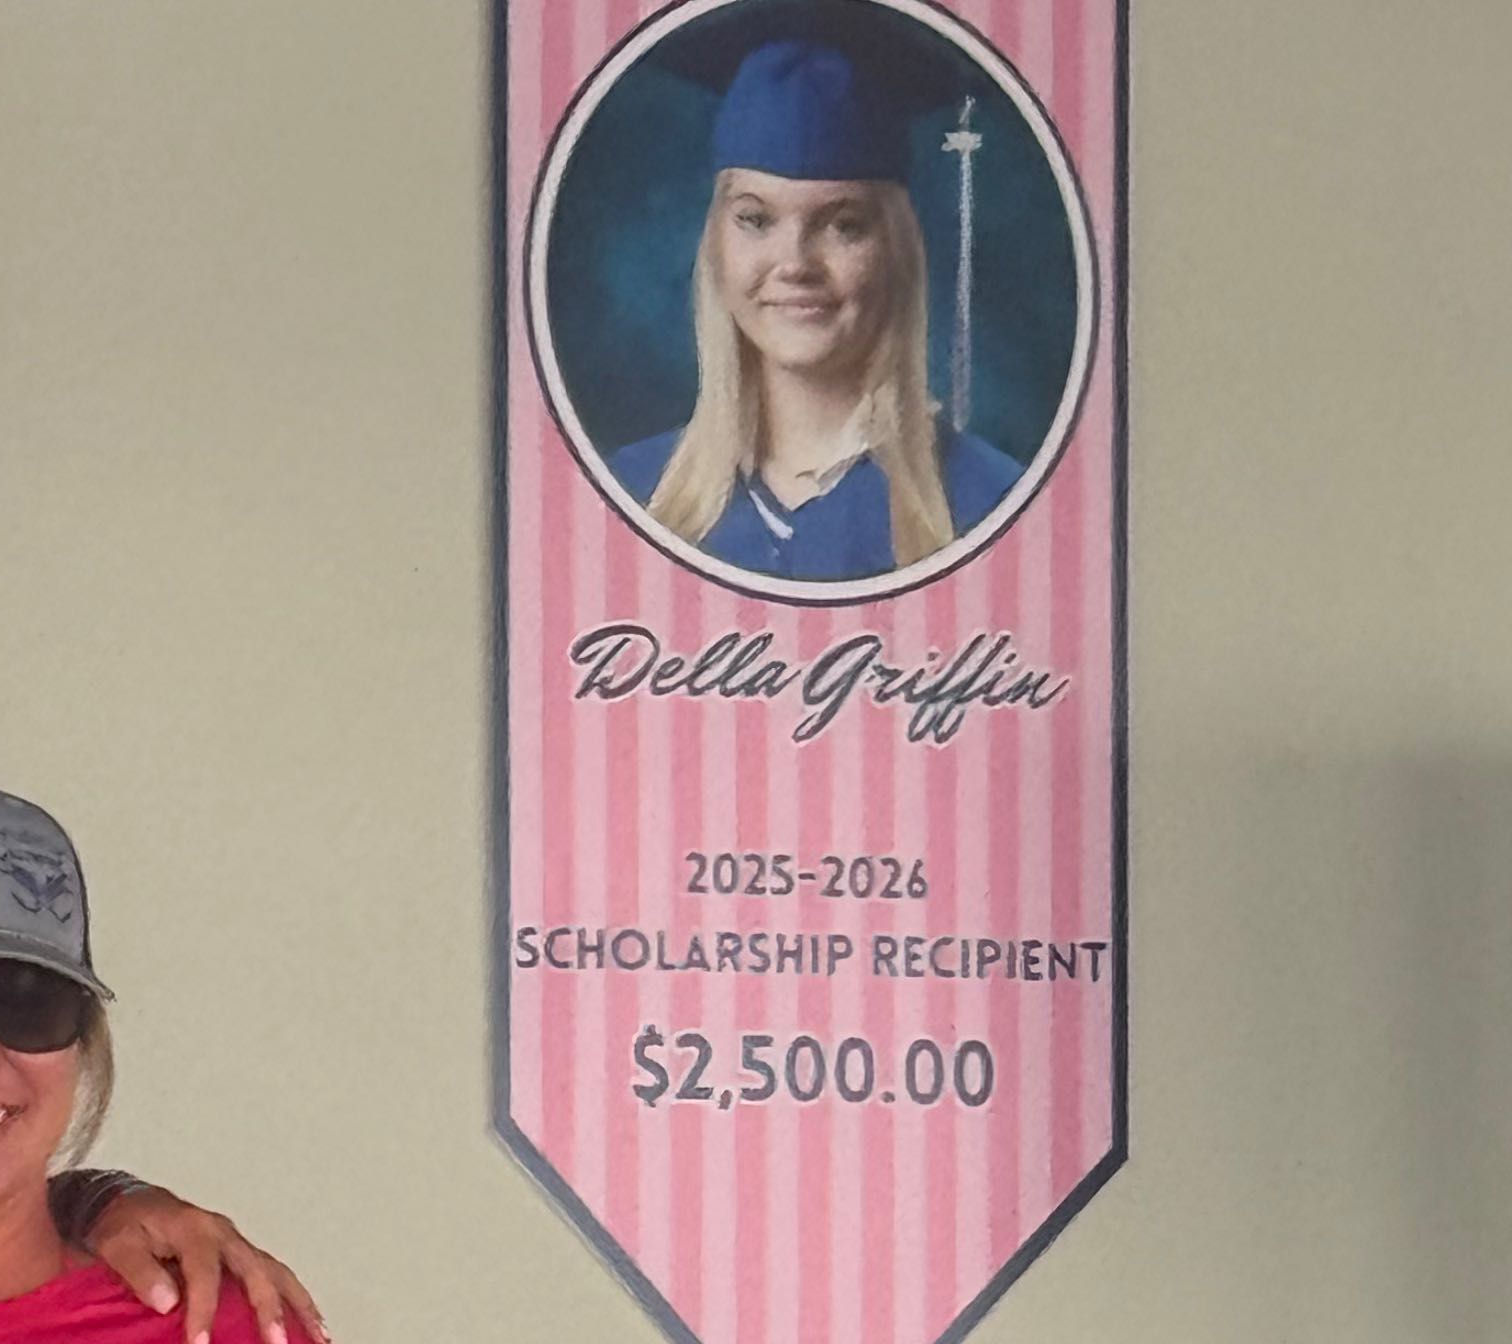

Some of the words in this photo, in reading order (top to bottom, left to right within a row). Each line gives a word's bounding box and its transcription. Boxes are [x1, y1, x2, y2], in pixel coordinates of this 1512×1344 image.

[570, 624, 802, 699] Della
[791, 633, 1070, 744] Griffin
[685, 852, 929, 899] 2025-2026
[514, 927, 853, 977] SCHOLARSHIP
[872, 937, 1108, 983] RECIPIENT
[632, 1023, 996, 1110] $2,500.00
